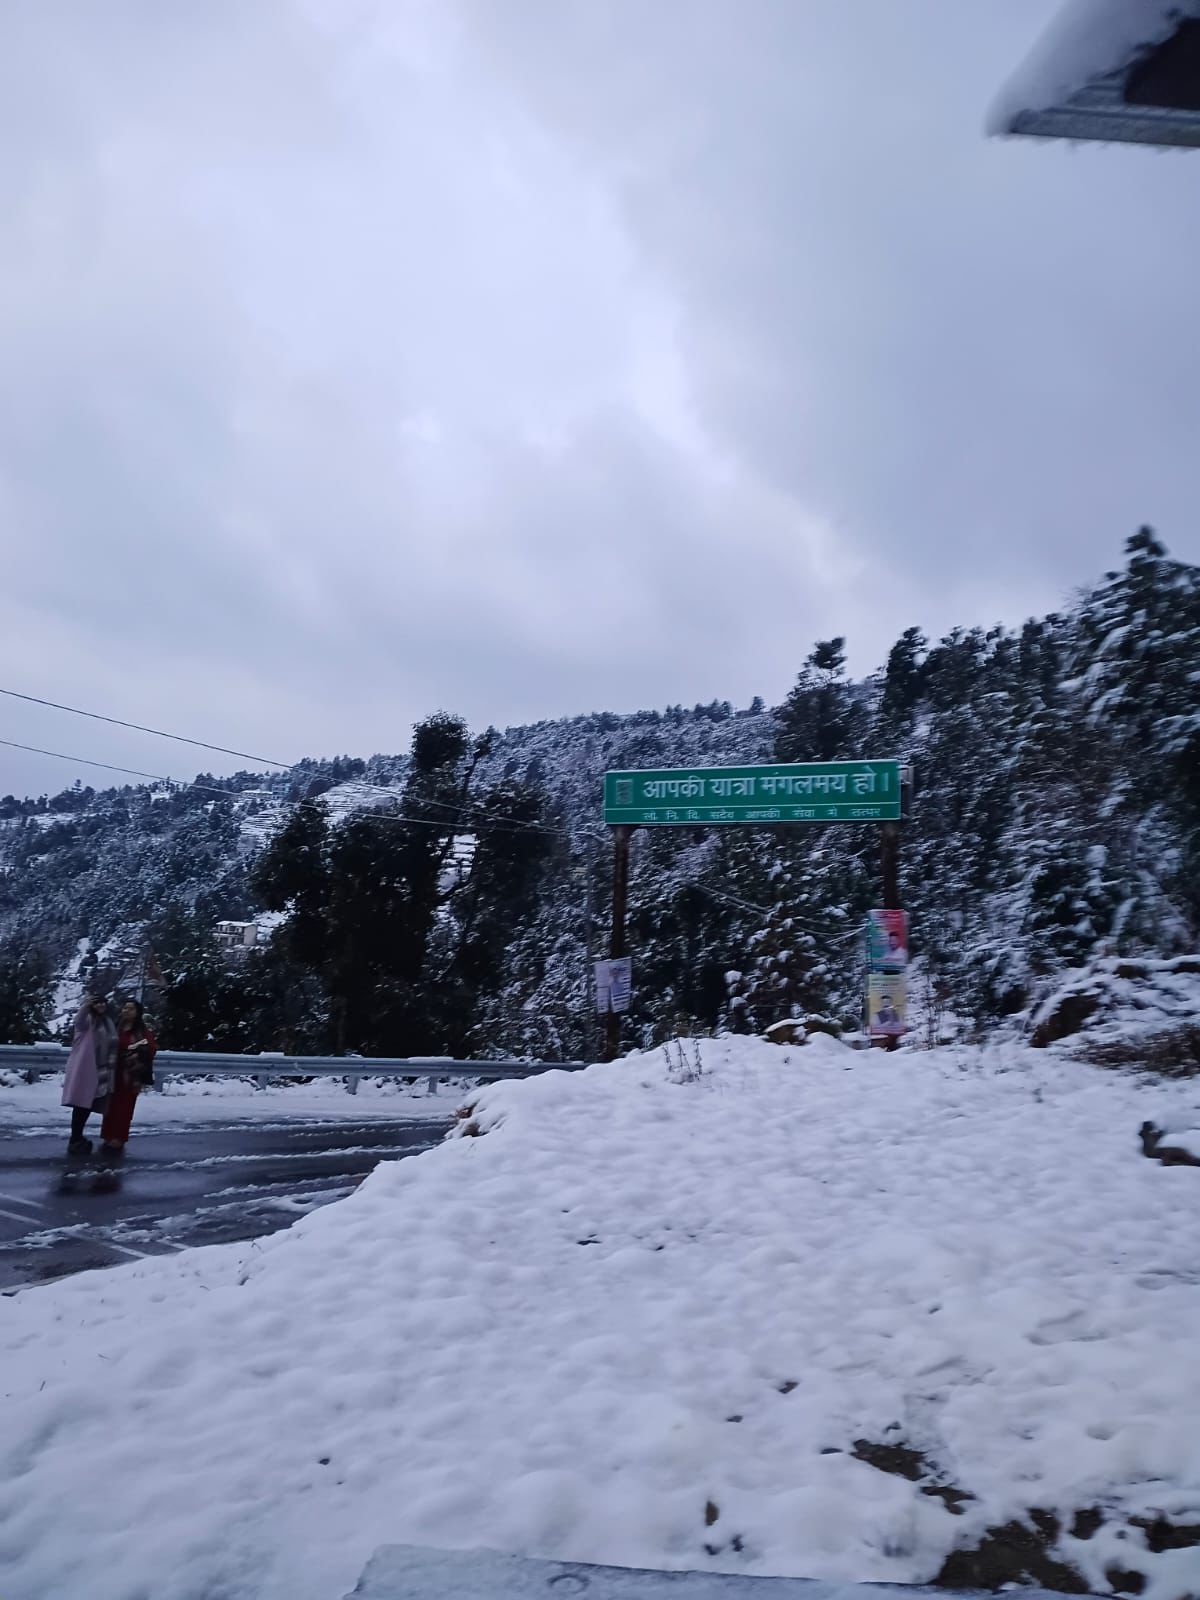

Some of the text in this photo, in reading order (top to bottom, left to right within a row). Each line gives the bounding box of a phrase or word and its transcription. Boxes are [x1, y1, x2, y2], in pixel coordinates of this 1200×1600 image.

[643, 775, 706, 798] आपकी
[709, 777, 756, 796] यात्रा
[760, 771, 848, 795] मंगलमय
[745, 807, 780, 819] आपकी
